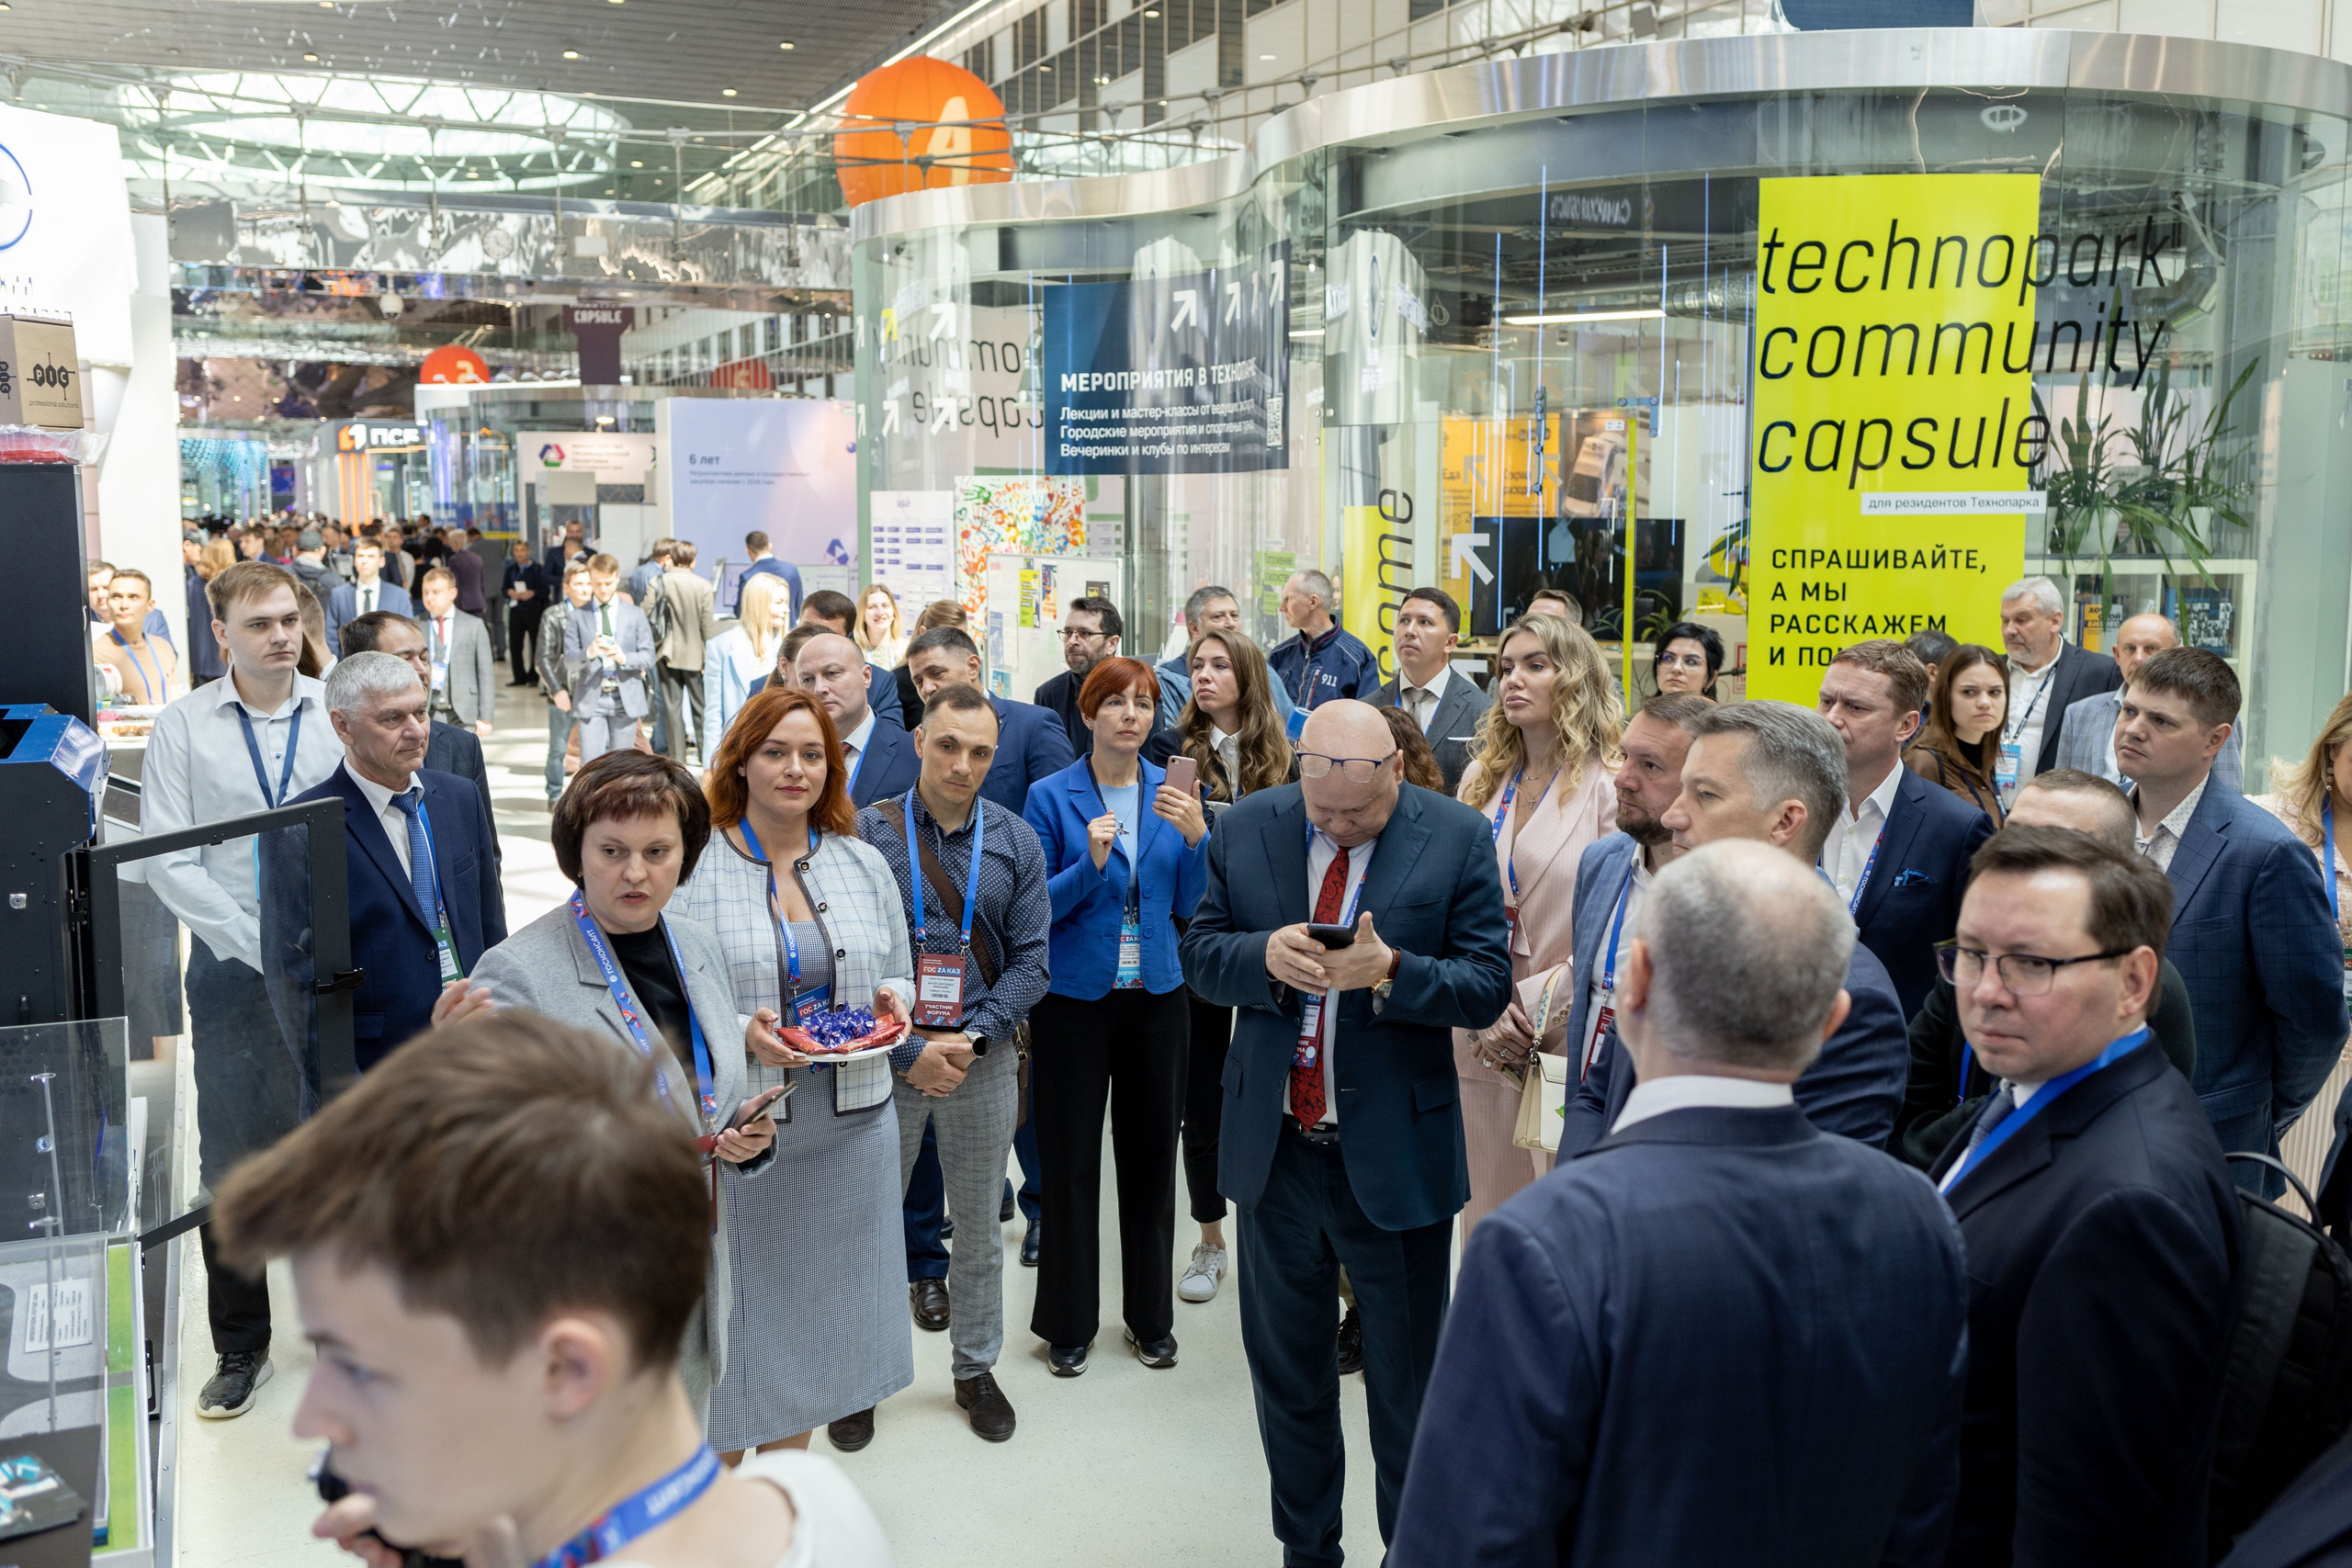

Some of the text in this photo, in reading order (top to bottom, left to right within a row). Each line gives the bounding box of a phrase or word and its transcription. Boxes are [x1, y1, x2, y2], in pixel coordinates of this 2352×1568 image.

[926, 96, 971, 186] 4
[1762, 215, 2170, 307] technopark
[573, 310, 623, 324] CAPSULE
[1759, 302, 2165, 391] community
[33, 365, 69, 387] PIC
[1061, 368, 1193, 392] МЕРОПРИЯТИЯ
[1198, 367, 1207, 386] В
[1060, 407, 1109, 422] Лекции
[1111, 408, 1119, 419] и
[1122, 404, 1199, 420] мастер-классы
[1200, 404, 1210, 415] от
[1060, 425, 1127, 441] Городские
[1130, 423, 1197, 439] мероприятия
[1198, 423, 1204, 434] и
[1060, 442, 1230, 459] Вечеринки и клубы по интересам
[1758, 397, 2052, 490] capsule
[689, 454, 720, 465] 6 лет
[1869, 497, 2040, 510] для резидентов Технопарка
[1771, 544, 1986, 573] СПРАШИВАЙТЕ,
[1770, 582, 1847, 601] А МЫ
[1770, 615, 1947, 634] РАССКАЖЕМ
[1770, 647, 1842, 666] И ПО
[1321, 673, 1338, 687] 911
[586, 930, 616, 974] ГОСКОНСАЛТ
